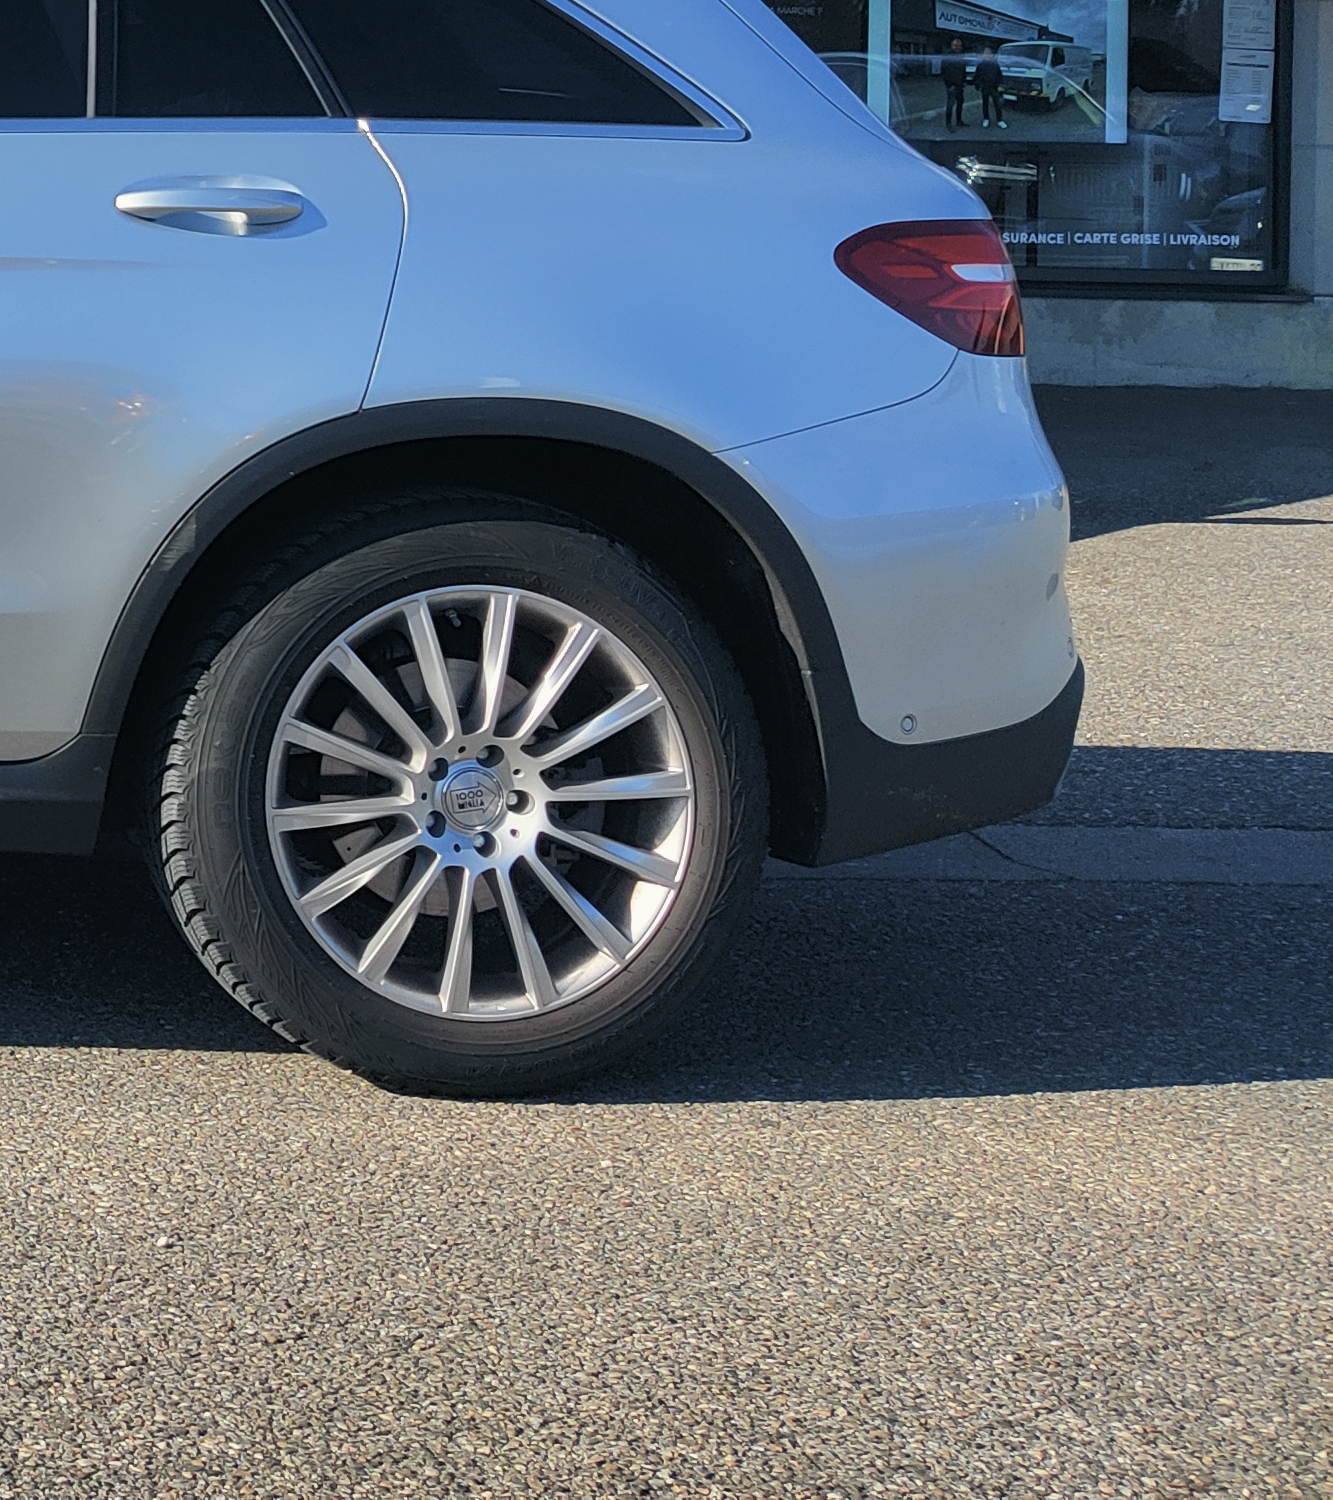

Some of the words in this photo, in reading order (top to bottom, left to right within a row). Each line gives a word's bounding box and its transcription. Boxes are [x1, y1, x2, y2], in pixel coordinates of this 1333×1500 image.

[1073, 232, 1118, 245] CARTE
[1120, 233, 1160, 246] GRISE
[1169, 234, 1240, 247] LIVRAISON
